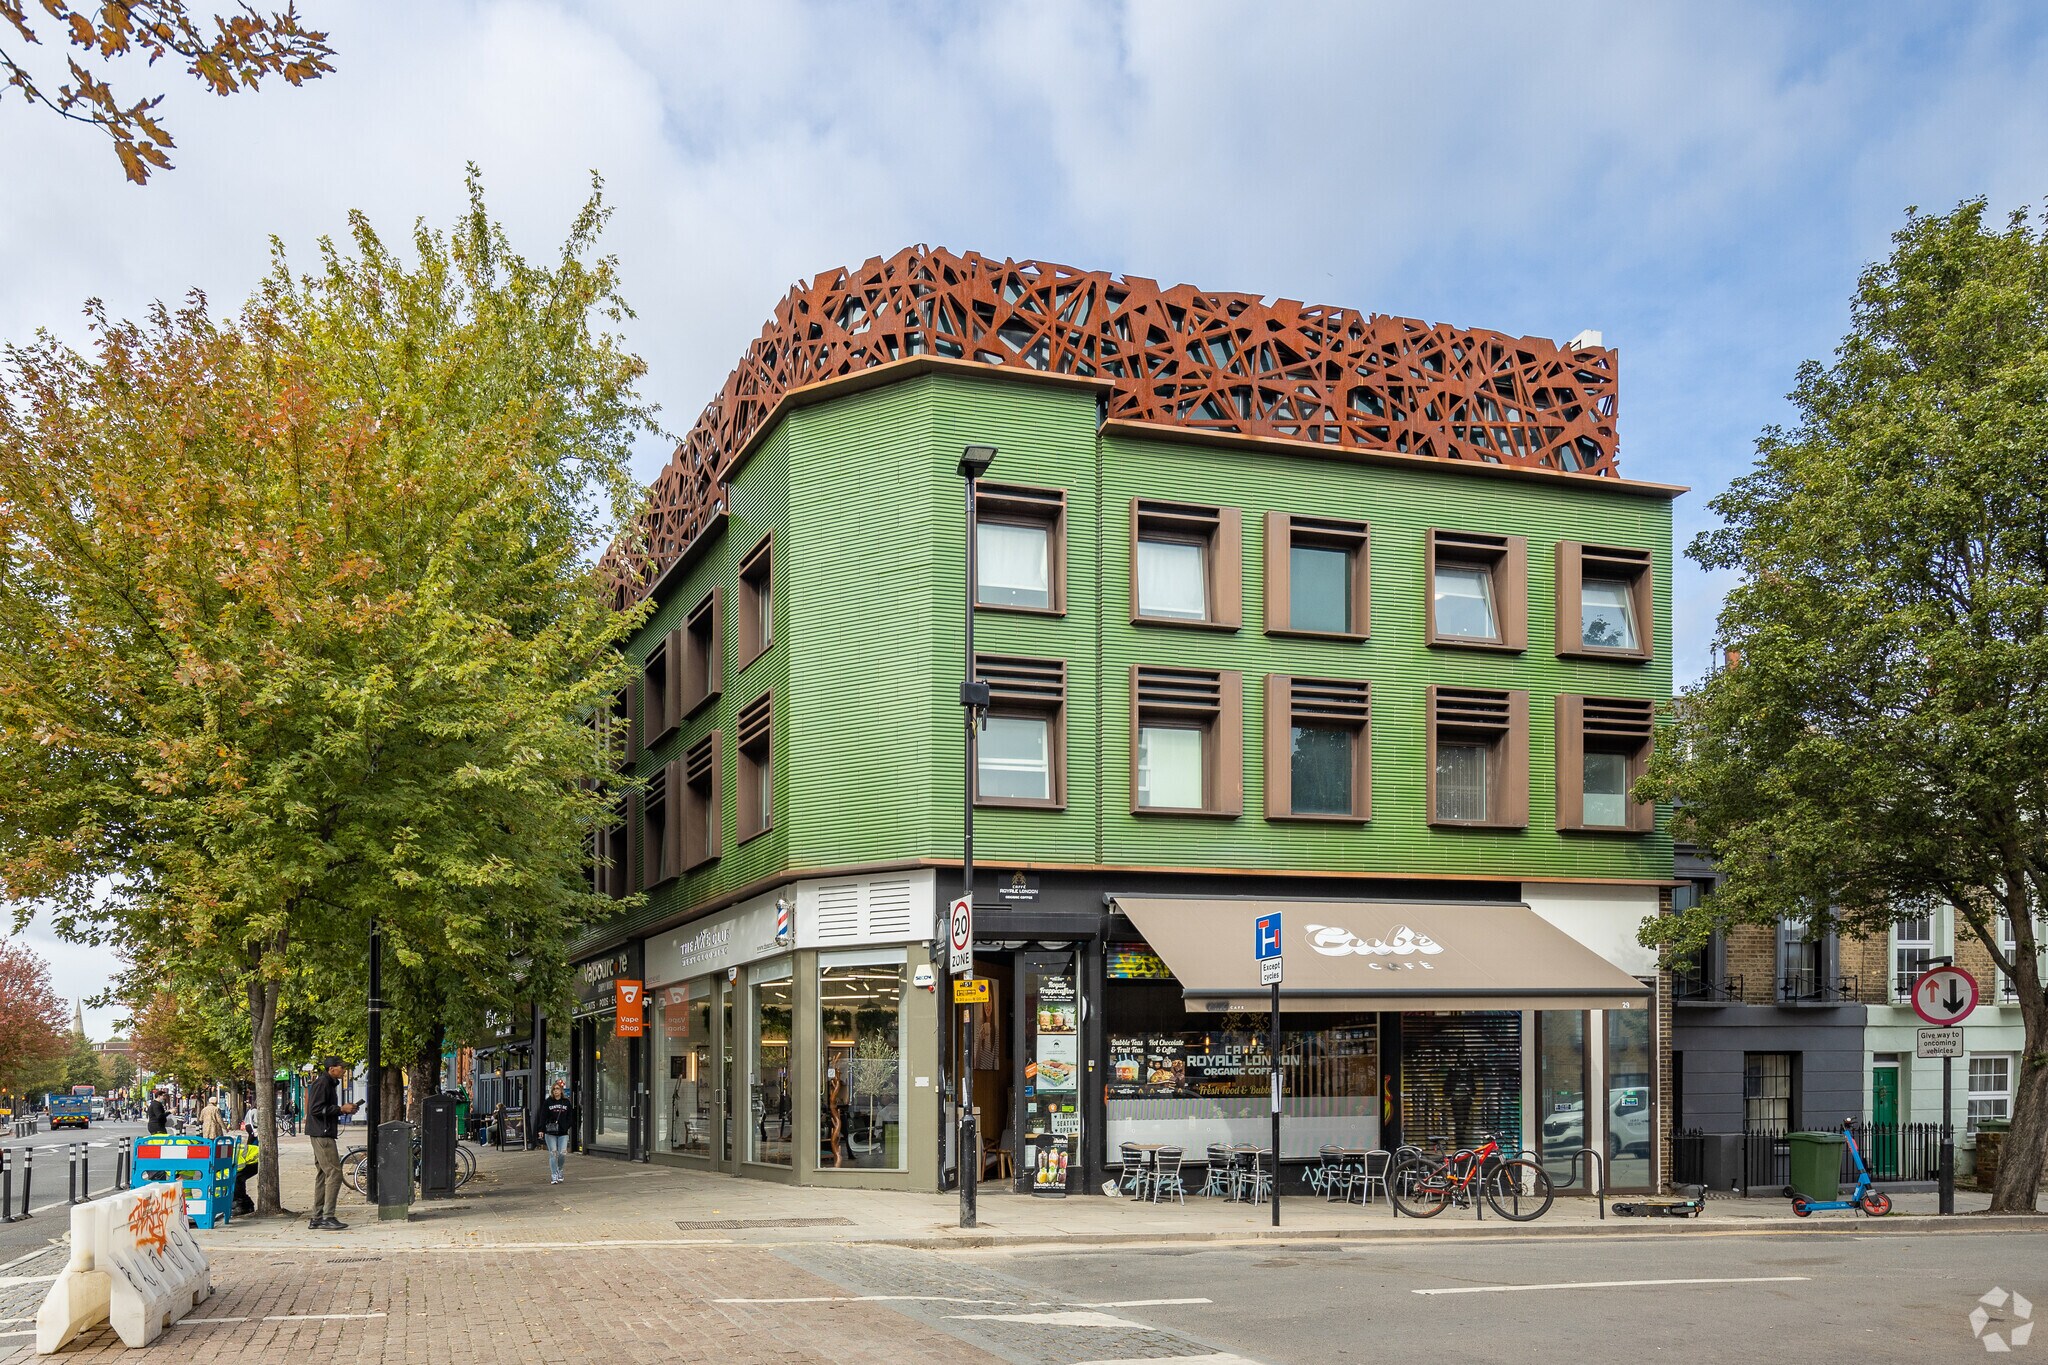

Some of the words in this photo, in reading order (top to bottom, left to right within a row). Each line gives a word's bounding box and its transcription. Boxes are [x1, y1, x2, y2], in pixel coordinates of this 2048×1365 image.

[954, 914, 968, 937] 20
[680, 941, 693, 955] THE
[694, 931, 711, 951] AXE
[712, 928, 731, 945] CLUB
[952, 952, 969, 967] ZONE
[1263, 961, 1281, 972] Except
[1264, 972, 1279, 981] cycles
[1162, 1046, 1177, 1054] Coffee
[1187, 1055, 1241, 1067] ROYALE
[1245, 1055, 1300, 1066] LONON
[1204, 1067, 1245, 1076] ORGANIC
[1248, 1067, 1284, 1075] COFFE
[1200, 1085, 1219, 1095] Fresh
[1221, 1085, 1240, 1094] Food
[1241, 1086, 1247, 1094] &
[1250, 1086, 1271, 1095] Bubb
